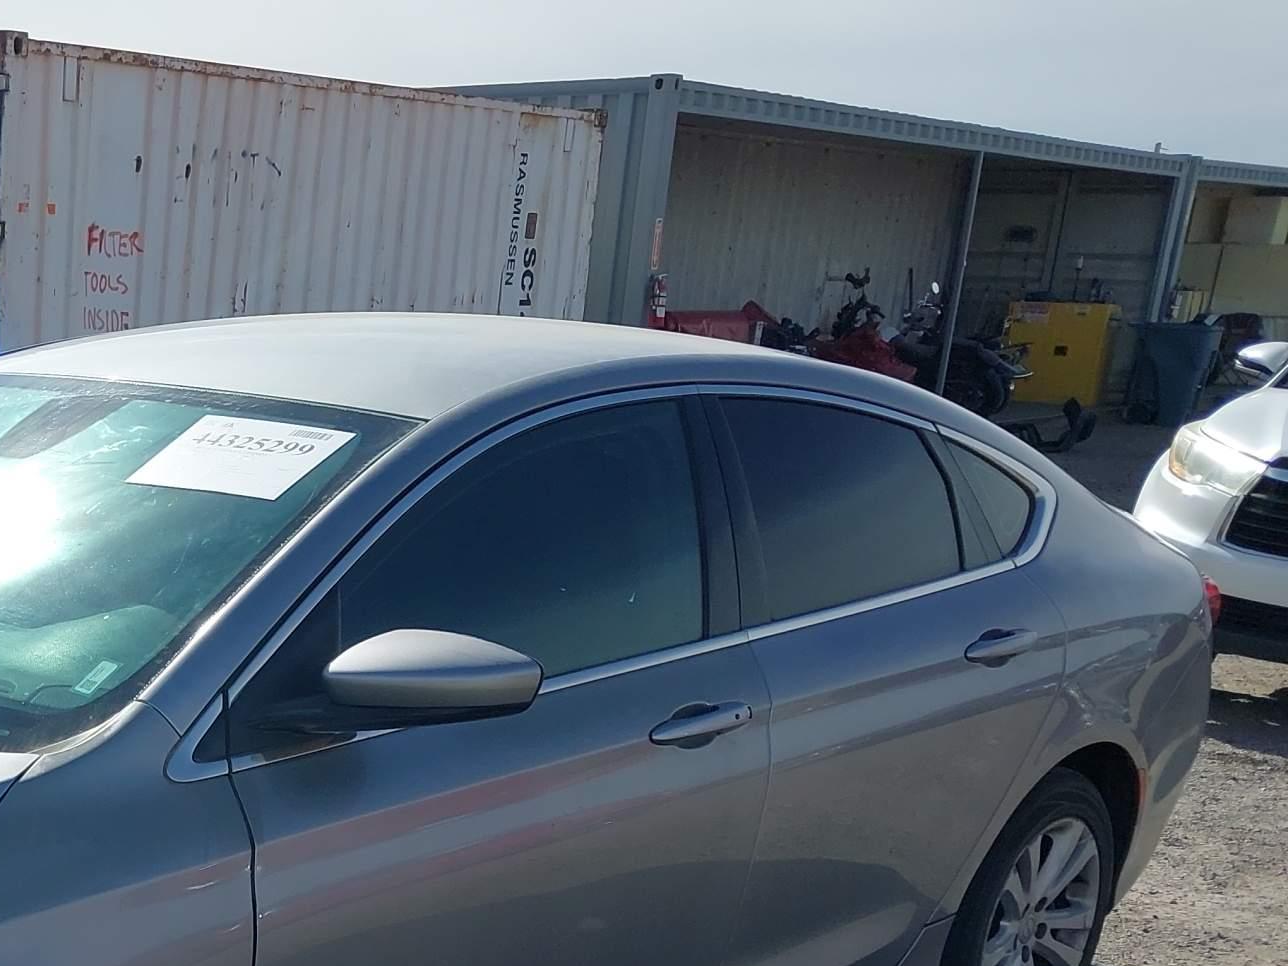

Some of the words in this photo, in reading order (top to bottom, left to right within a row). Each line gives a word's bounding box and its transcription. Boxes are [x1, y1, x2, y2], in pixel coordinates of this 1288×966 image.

[504, 153, 528, 286] RASMUSSEN
[87, 223, 144, 258] FILTER
[84, 271, 129, 297] TOOLS
[518, 247, 537, 317] SC1
[83, 306, 129, 332] INSIDE
[192, 431, 316, 456] 44325299
